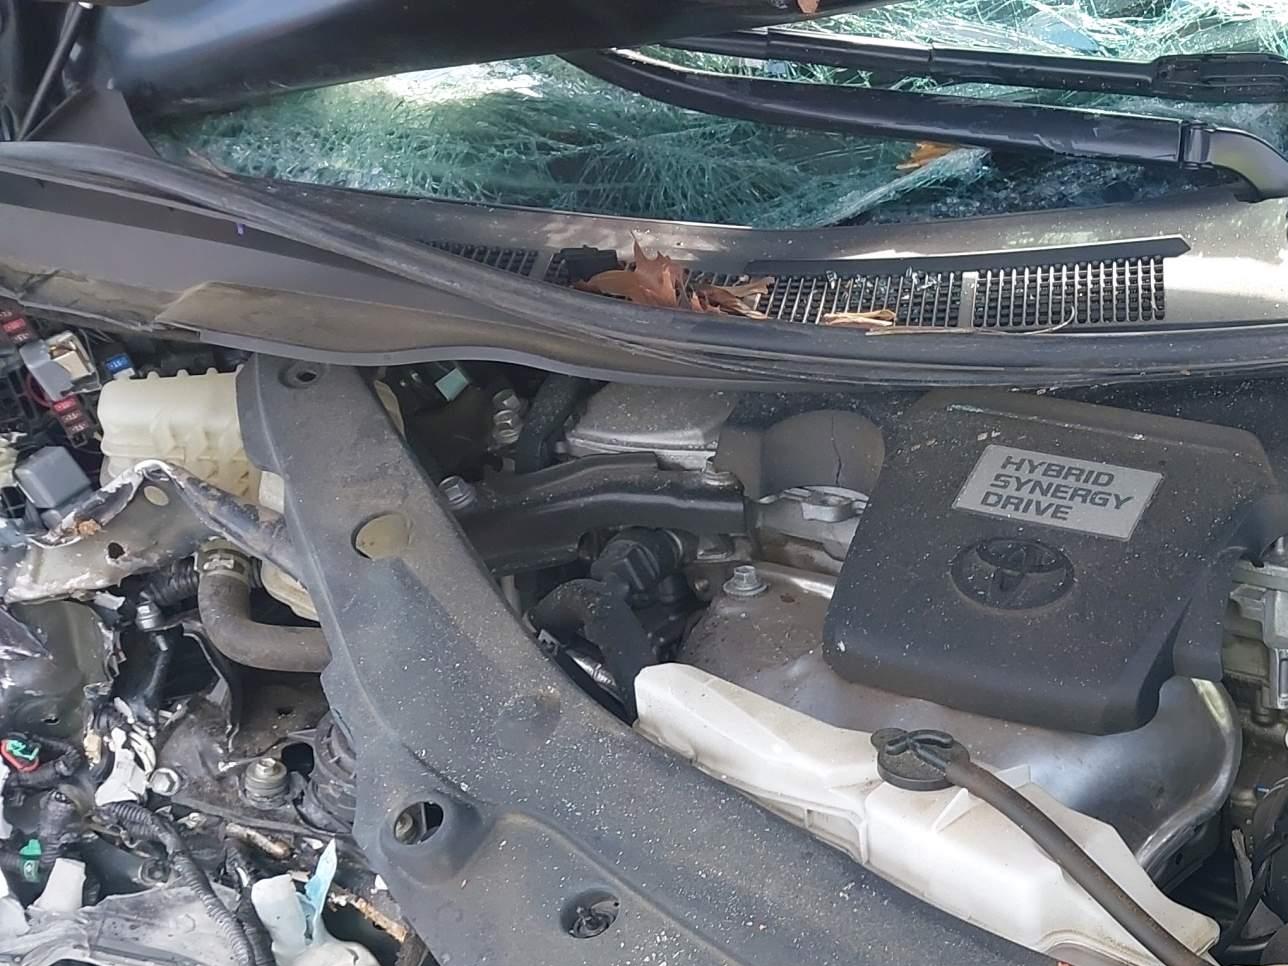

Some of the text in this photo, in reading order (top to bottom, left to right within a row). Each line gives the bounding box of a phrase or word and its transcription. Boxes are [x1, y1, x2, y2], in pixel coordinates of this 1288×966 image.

[1000, 455, 1115, 487] HYBRID
[980, 491, 1073, 521] DRIVE
[989, 473, 1135, 510] SYNERGY
